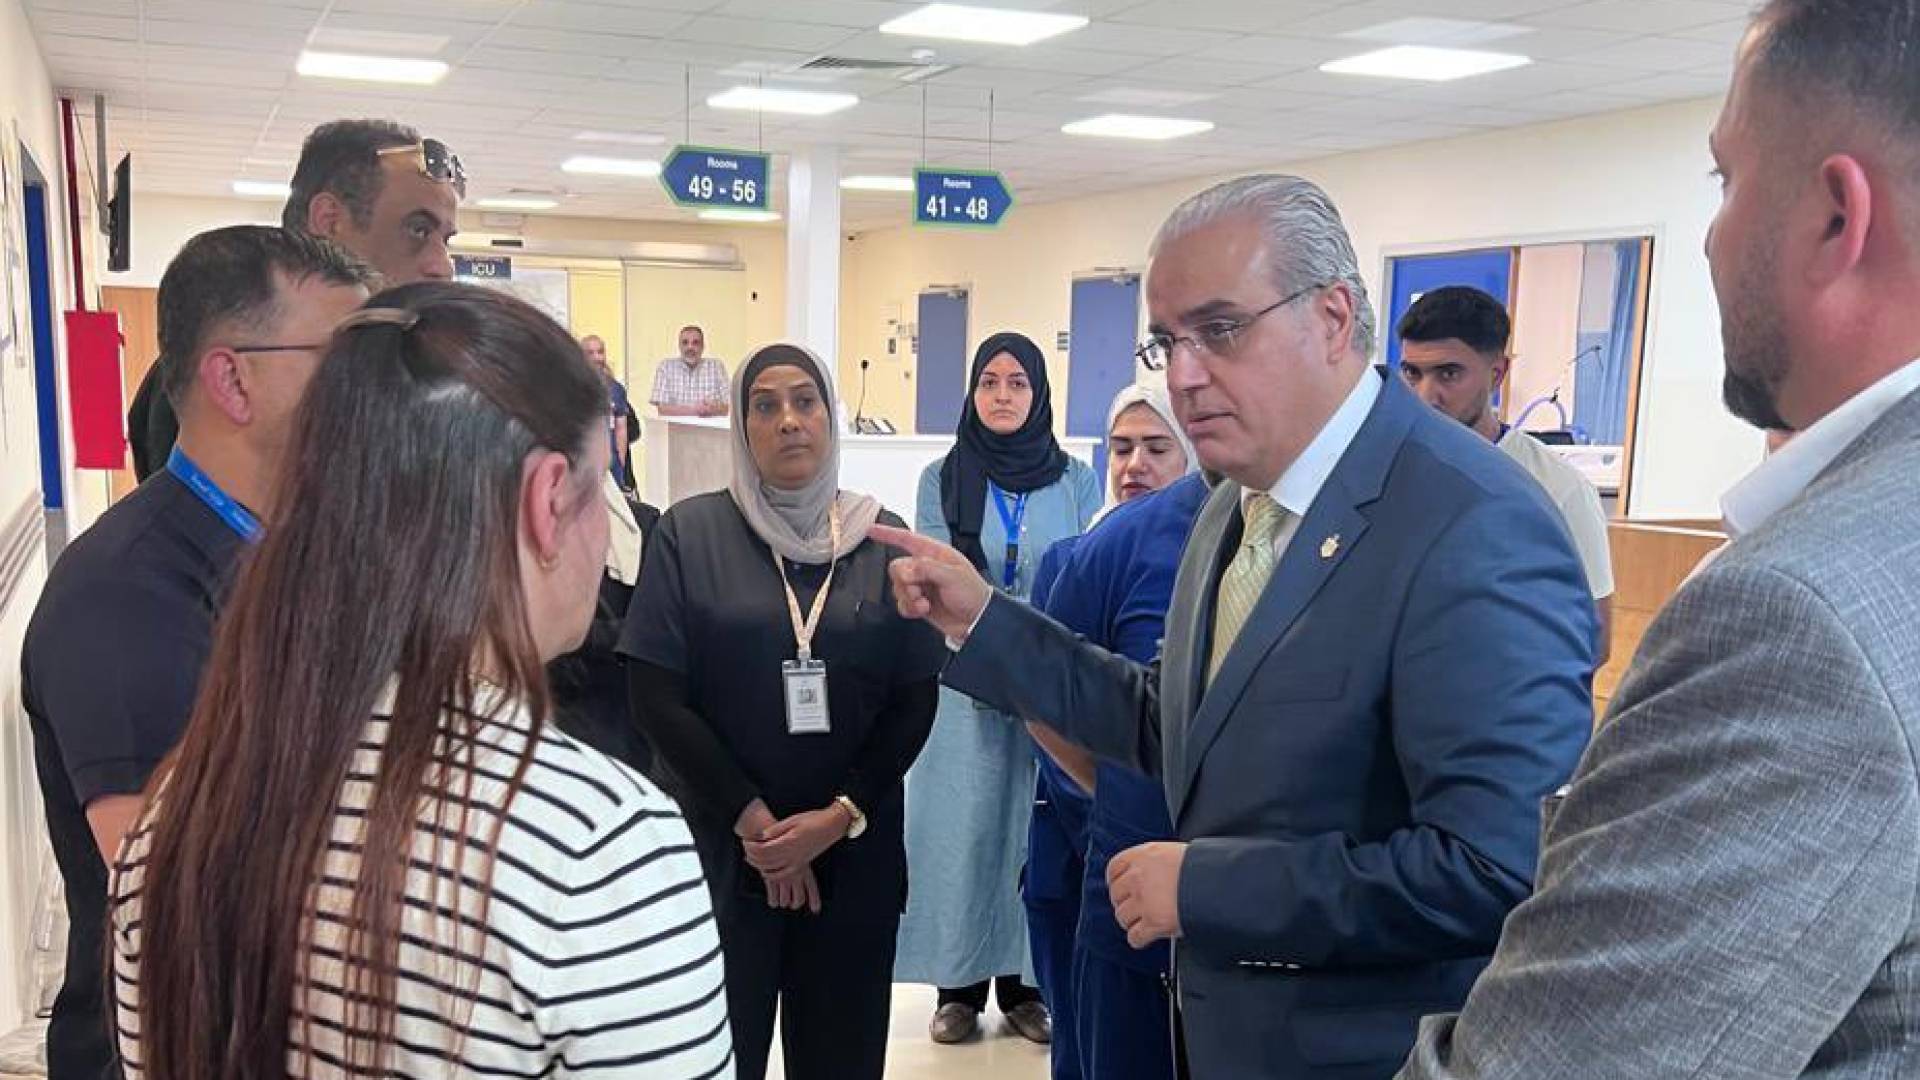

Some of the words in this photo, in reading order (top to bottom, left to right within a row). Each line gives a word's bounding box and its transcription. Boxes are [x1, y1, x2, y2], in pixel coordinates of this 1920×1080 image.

[688, 174, 713, 200] 49
[719, 187, 727, 195] -
[732, 178, 756, 203] 56
[926, 195, 946, 218] 41
[965, 196, 988, 220] 48
[471, 262, 496, 276] ICU
